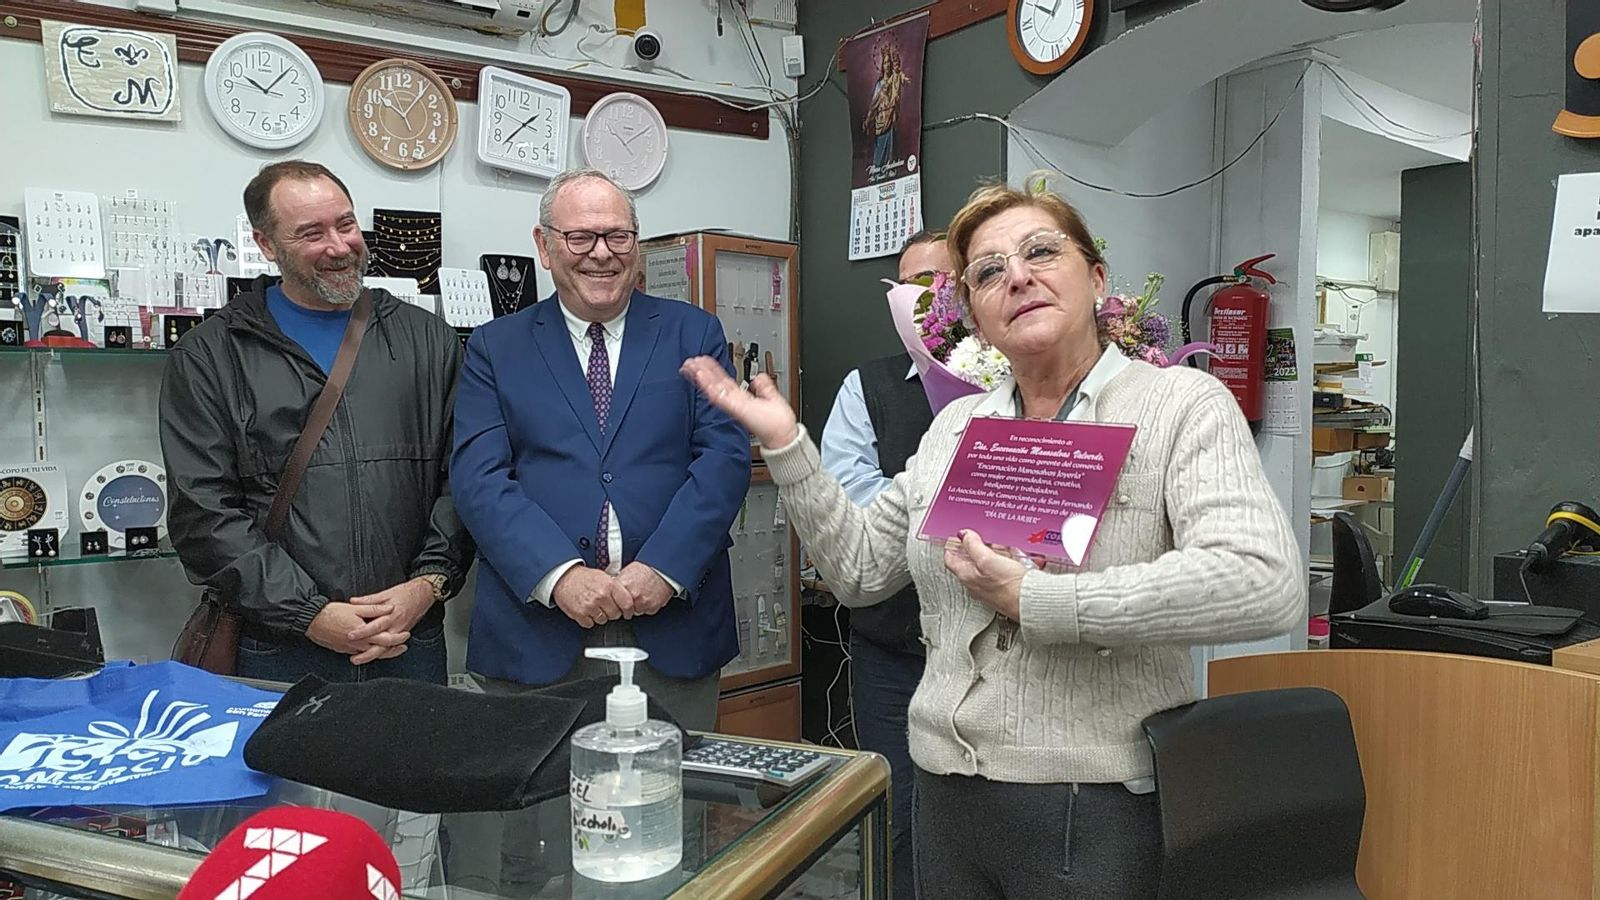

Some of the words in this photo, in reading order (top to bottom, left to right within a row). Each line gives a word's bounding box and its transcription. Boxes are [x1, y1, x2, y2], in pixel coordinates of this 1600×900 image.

[245, 53, 254, 69] 11
[258, 51, 271, 68] 12
[280, 58, 283, 73] 1
[230, 62, 243, 78] 10
[290, 69, 299, 85] 2
[224, 79, 234, 95] 9
[379, 75, 394, 91] 11
[395, 72, 412, 89] 12
[113, 77, 161, 107] M
[297, 88, 307, 103] 3
[508, 88, 516, 103] 11
[520, 91, 530, 106] 12
[231, 98, 241, 114] 8
[428, 94, 438, 109] 2
[495, 94, 506, 109] 10
[537, 97, 540, 110] 1
[246, 110, 257, 126] 7
[290, 106, 301, 120] 4
[364, 103, 374, 119] 9
[494, 111, 502, 124] 9
[545, 107, 553, 122] 2
[261, 116, 271, 131] 6
[433, 112, 442, 127] 3
[368, 121, 378, 137] 8
[427, 128, 438, 144] 4
[494, 128, 502, 142] 8
[545, 125, 552, 138] 3
[381, 136, 391, 151] 7
[399, 142, 408, 157] 6
[506, 140, 514, 153] 7
[542, 142, 550, 155] 4
[518, 147, 526, 158] 6
[531, 147, 540, 160] 5
[1273, 367, 1297, 377] 2023
[1018, 436, 1066, 445] reconocimiento
[1061, 460, 1072, 468] del
[1072, 463, 1103, 471] comercio
[103, 495, 160, 507] Constelaciones
[956, 486, 987, 496] Asociación
[996, 491, 1037, 502] Comerciantes
[1047, 498, 1060, 506] San
[1061, 499, 1093, 510] Fernando
[955, 497, 990, 506] conmemora
[995, 501, 1016, 509] felicita
[1037, 507, 1058, 515] marzo
[1059, 509, 1069, 517] de
